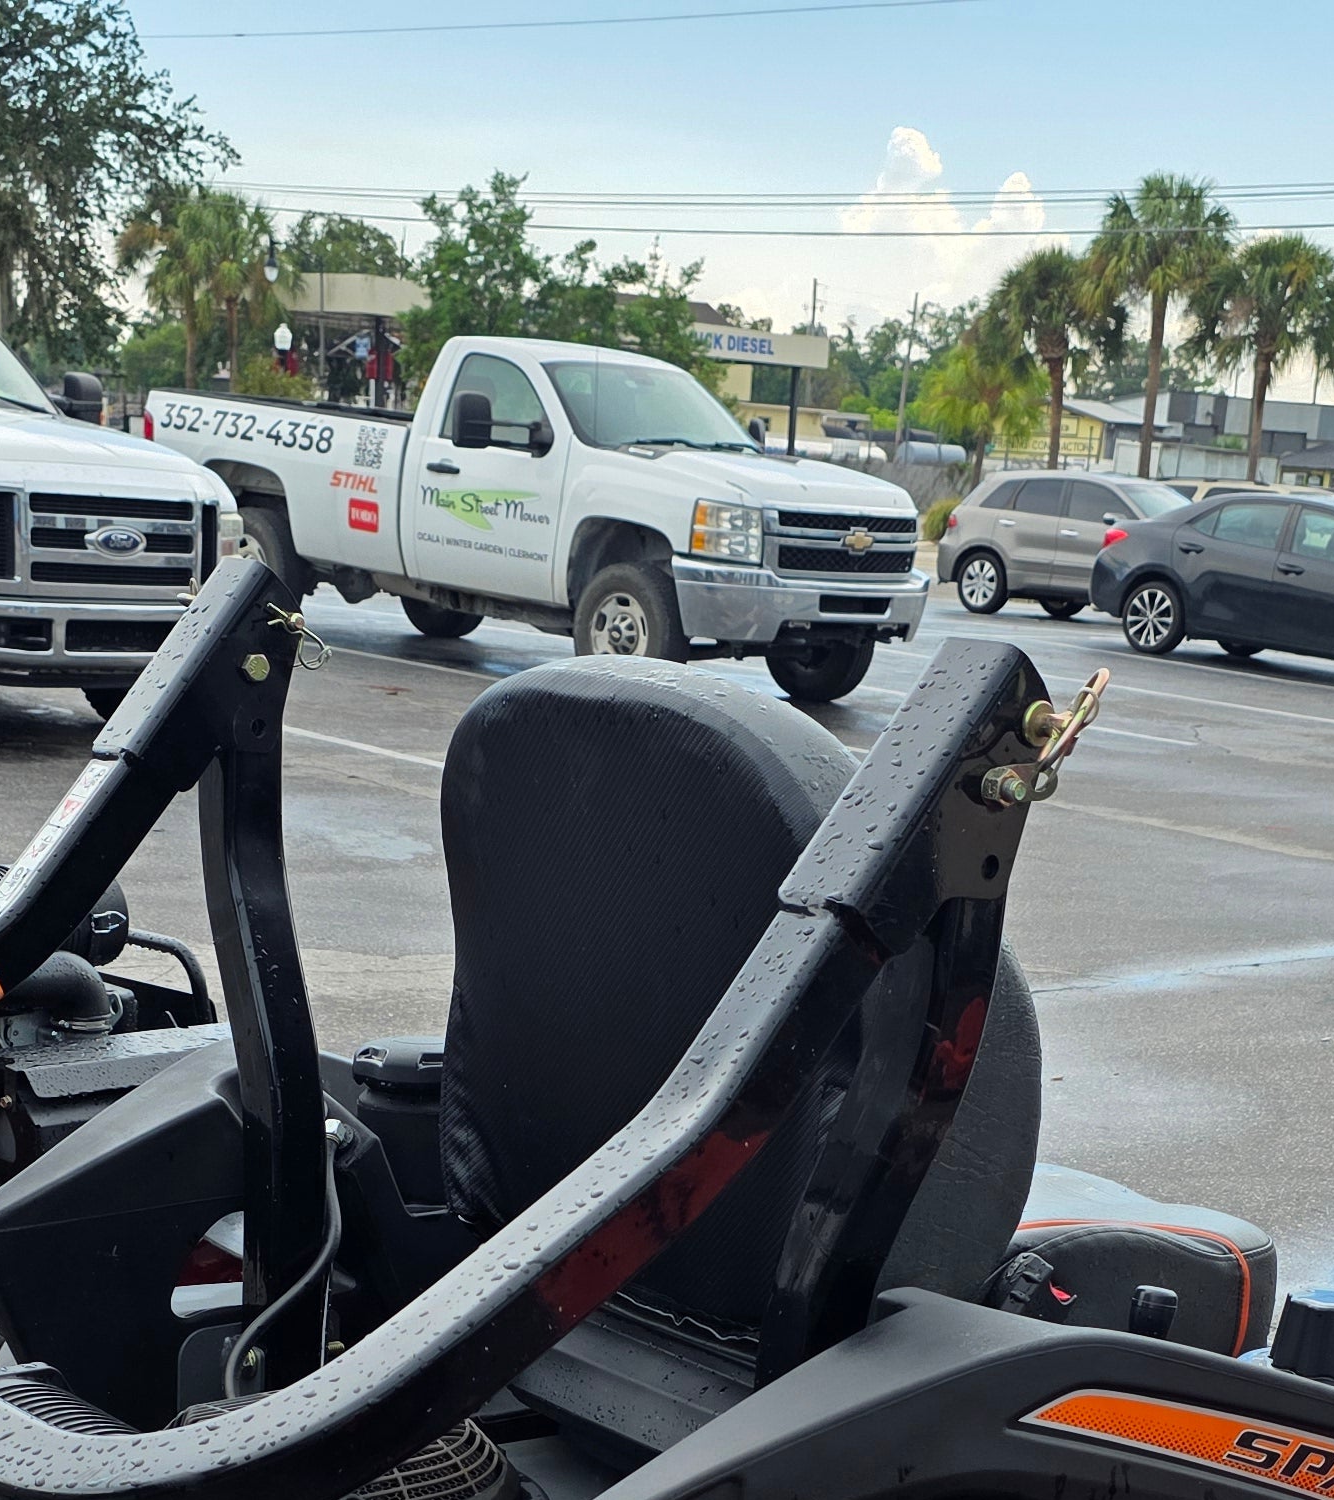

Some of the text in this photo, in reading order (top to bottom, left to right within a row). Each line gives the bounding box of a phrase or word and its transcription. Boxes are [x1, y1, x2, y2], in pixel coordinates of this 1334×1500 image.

[727, 335, 774, 355] DIESEL
[160, 402, 335, 454] 352-732-4358
[330, 470, 378, 493] STIHL
[420, 484, 551, 525] Main Street Mower
[417, 531, 549, 562] OCALA WINTER GARDEN CLERMONT
